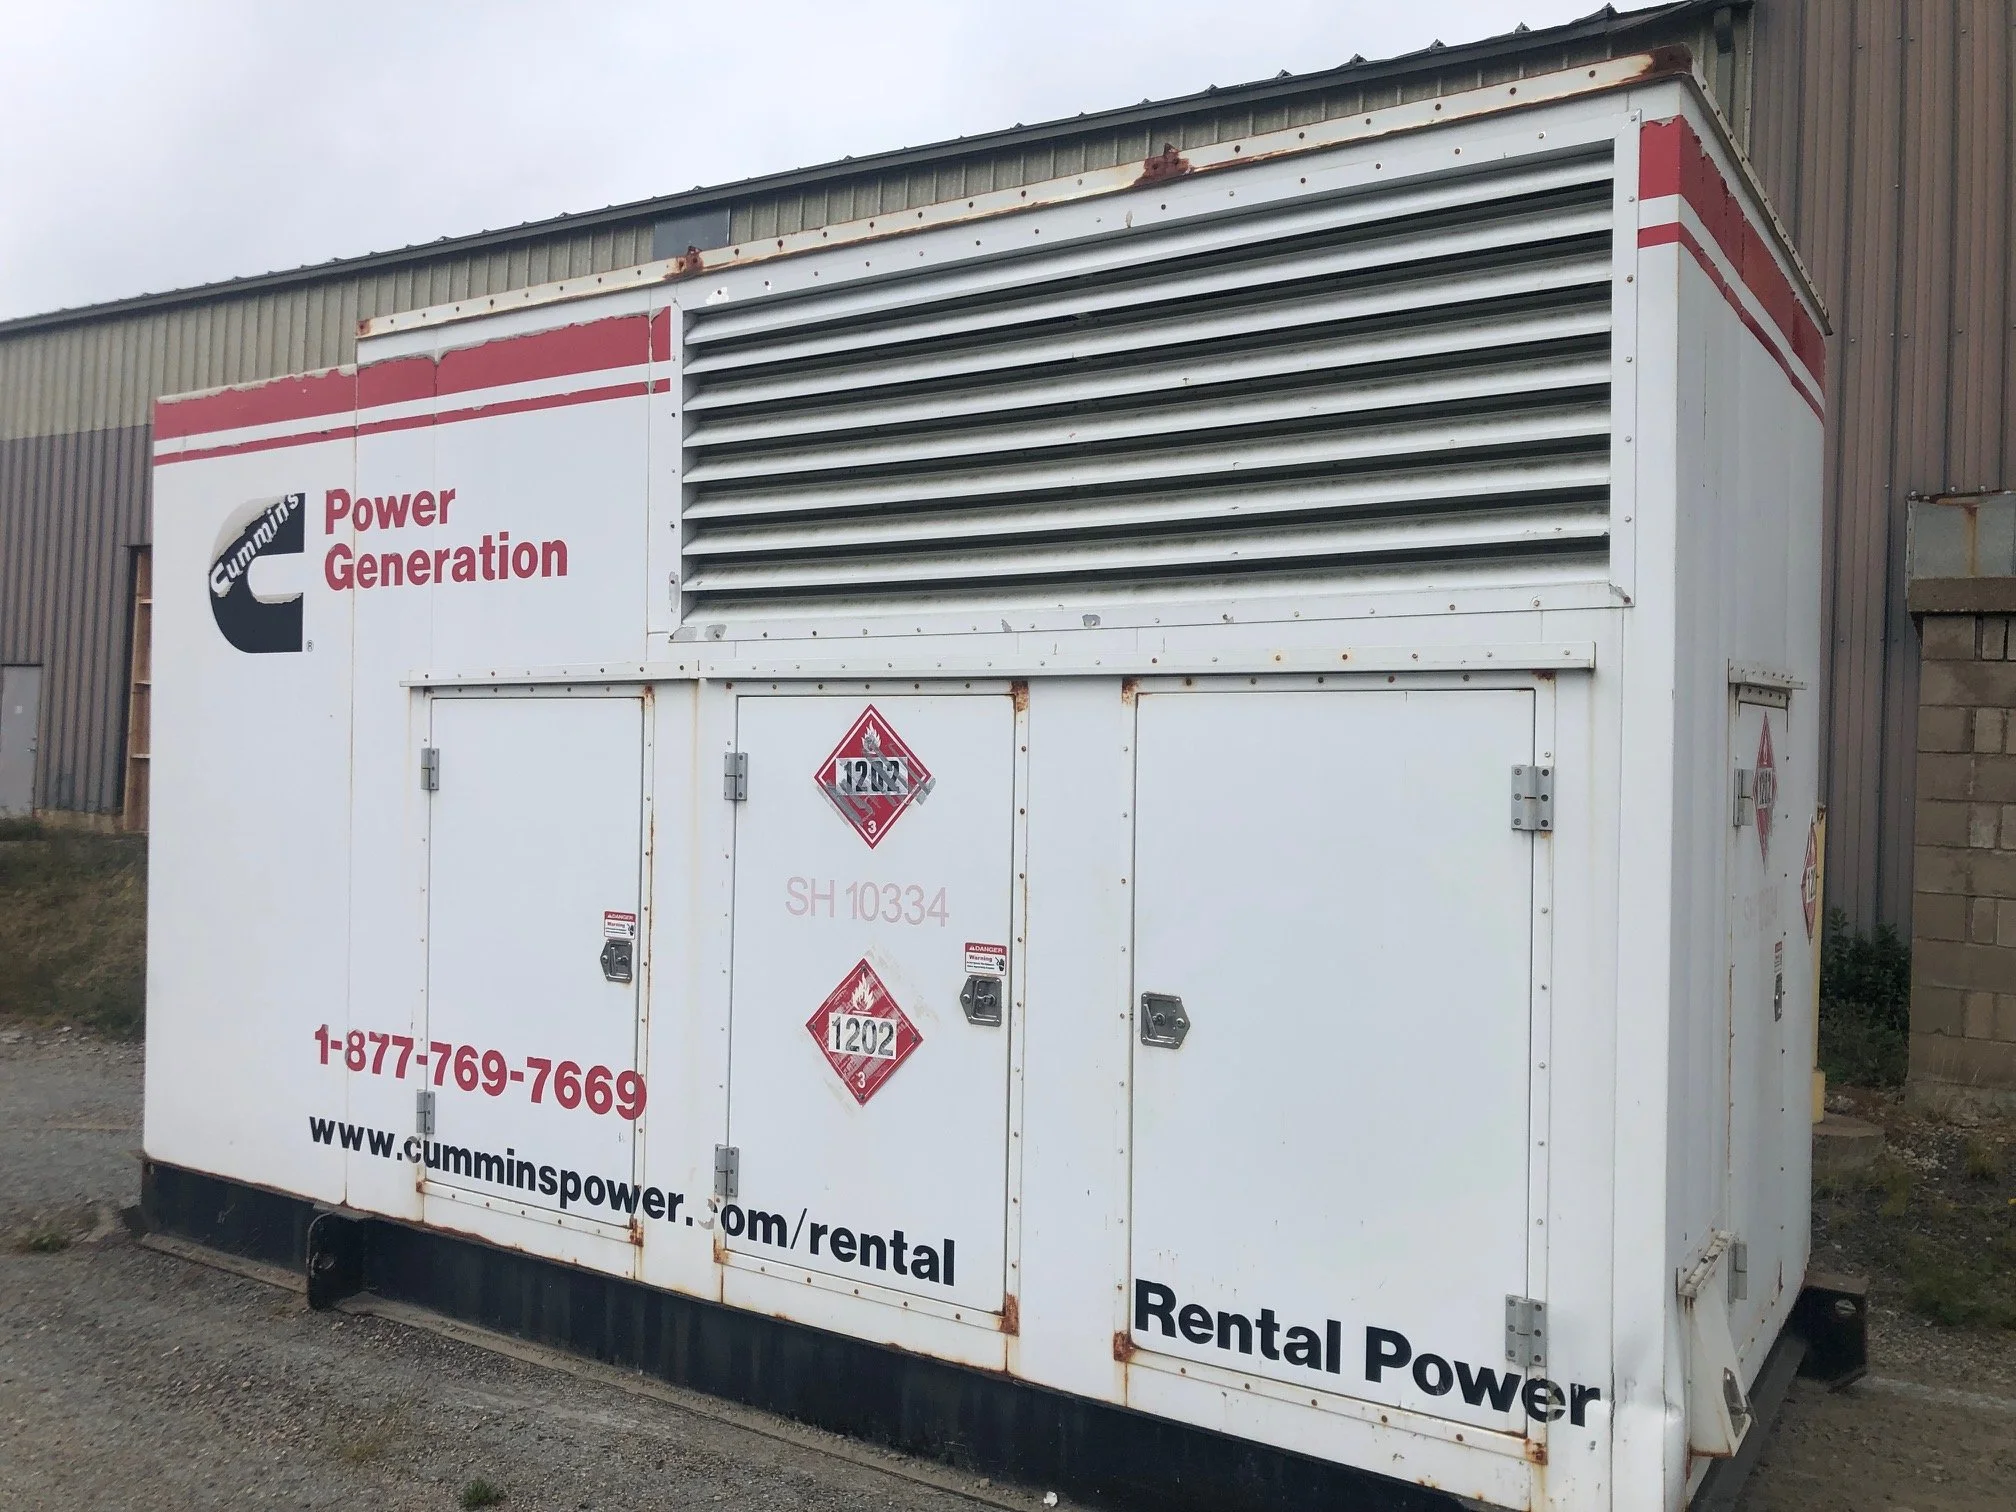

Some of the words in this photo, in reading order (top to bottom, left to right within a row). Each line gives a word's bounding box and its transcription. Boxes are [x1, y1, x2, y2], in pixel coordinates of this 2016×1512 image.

[325, 488, 456, 535] Power
[210, 494, 300, 595] Cummins
[324, 531, 568, 591] Generation
[867, 820, 877, 834] 3
[785, 876, 835, 918] SH
[846, 881, 950, 927] 10334
[969, 954, 993, 962] Warning
[975, 945, 1003, 954] DANGER
[831, 1016, 894, 1056] 1202
[314, 1024, 647, 1121] 1-877-769-7669
[857, 1071, 866, 1088] 3
[1135, 1278, 1341, 1375] Rental
[1365, 1326, 1601, 1428] Power
